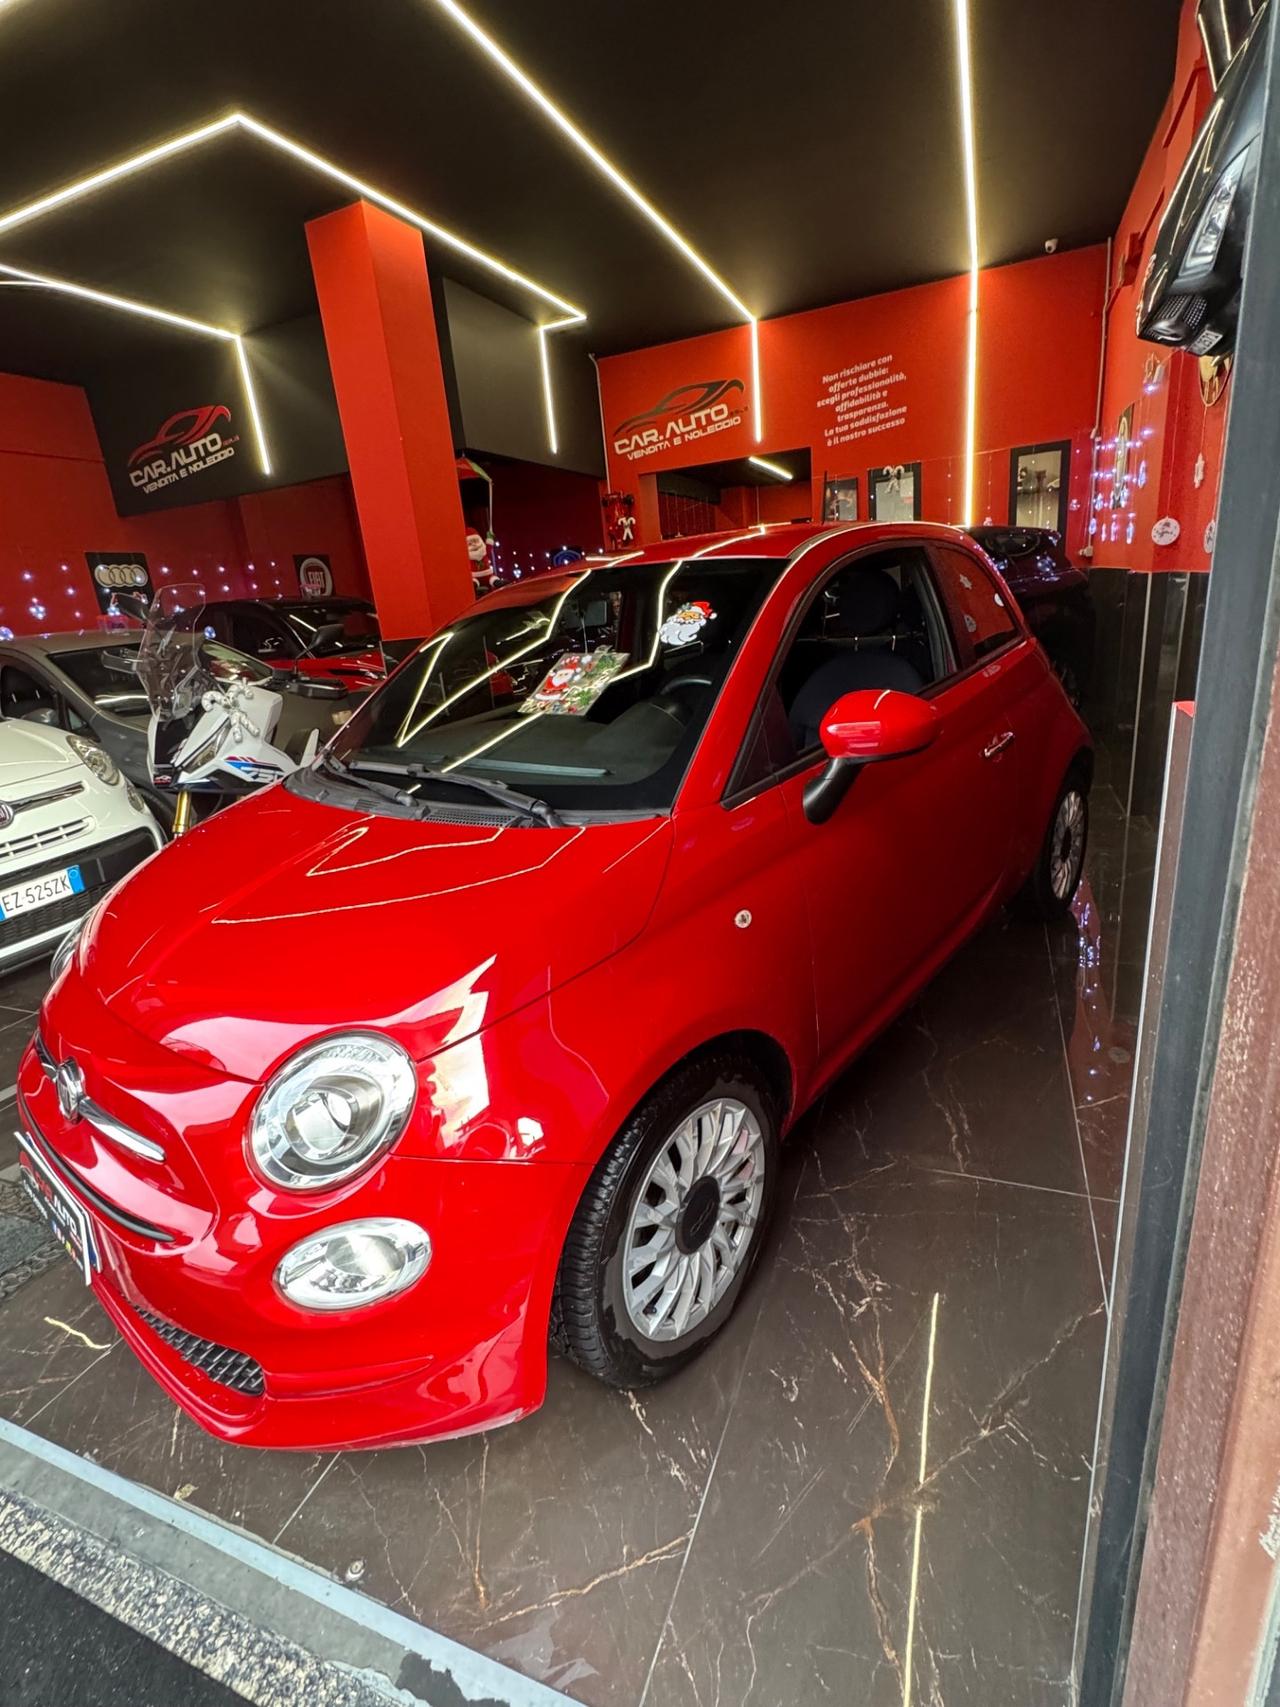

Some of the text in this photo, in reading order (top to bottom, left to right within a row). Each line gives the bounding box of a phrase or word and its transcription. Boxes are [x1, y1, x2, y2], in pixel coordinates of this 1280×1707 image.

[822, 354, 893, 384] Non rischiare con
[828, 377, 857, 393] offerte
[816, 393, 841, 408] scegli
[614, 403, 728, 455] CAR.AUTO
[824, 406, 907, 437] La tua soddisfazione
[833, 436, 839, 445] il
[840, 429, 867, 443] nostro
[867, 418, 906, 435] successo
[627, 416, 741, 460] VENDITA E NOLEGGIO
[129, 433, 222, 487] CAR.AUTO
[143, 473, 179, 494] VENDITA
[179, 469, 188, 478] E
